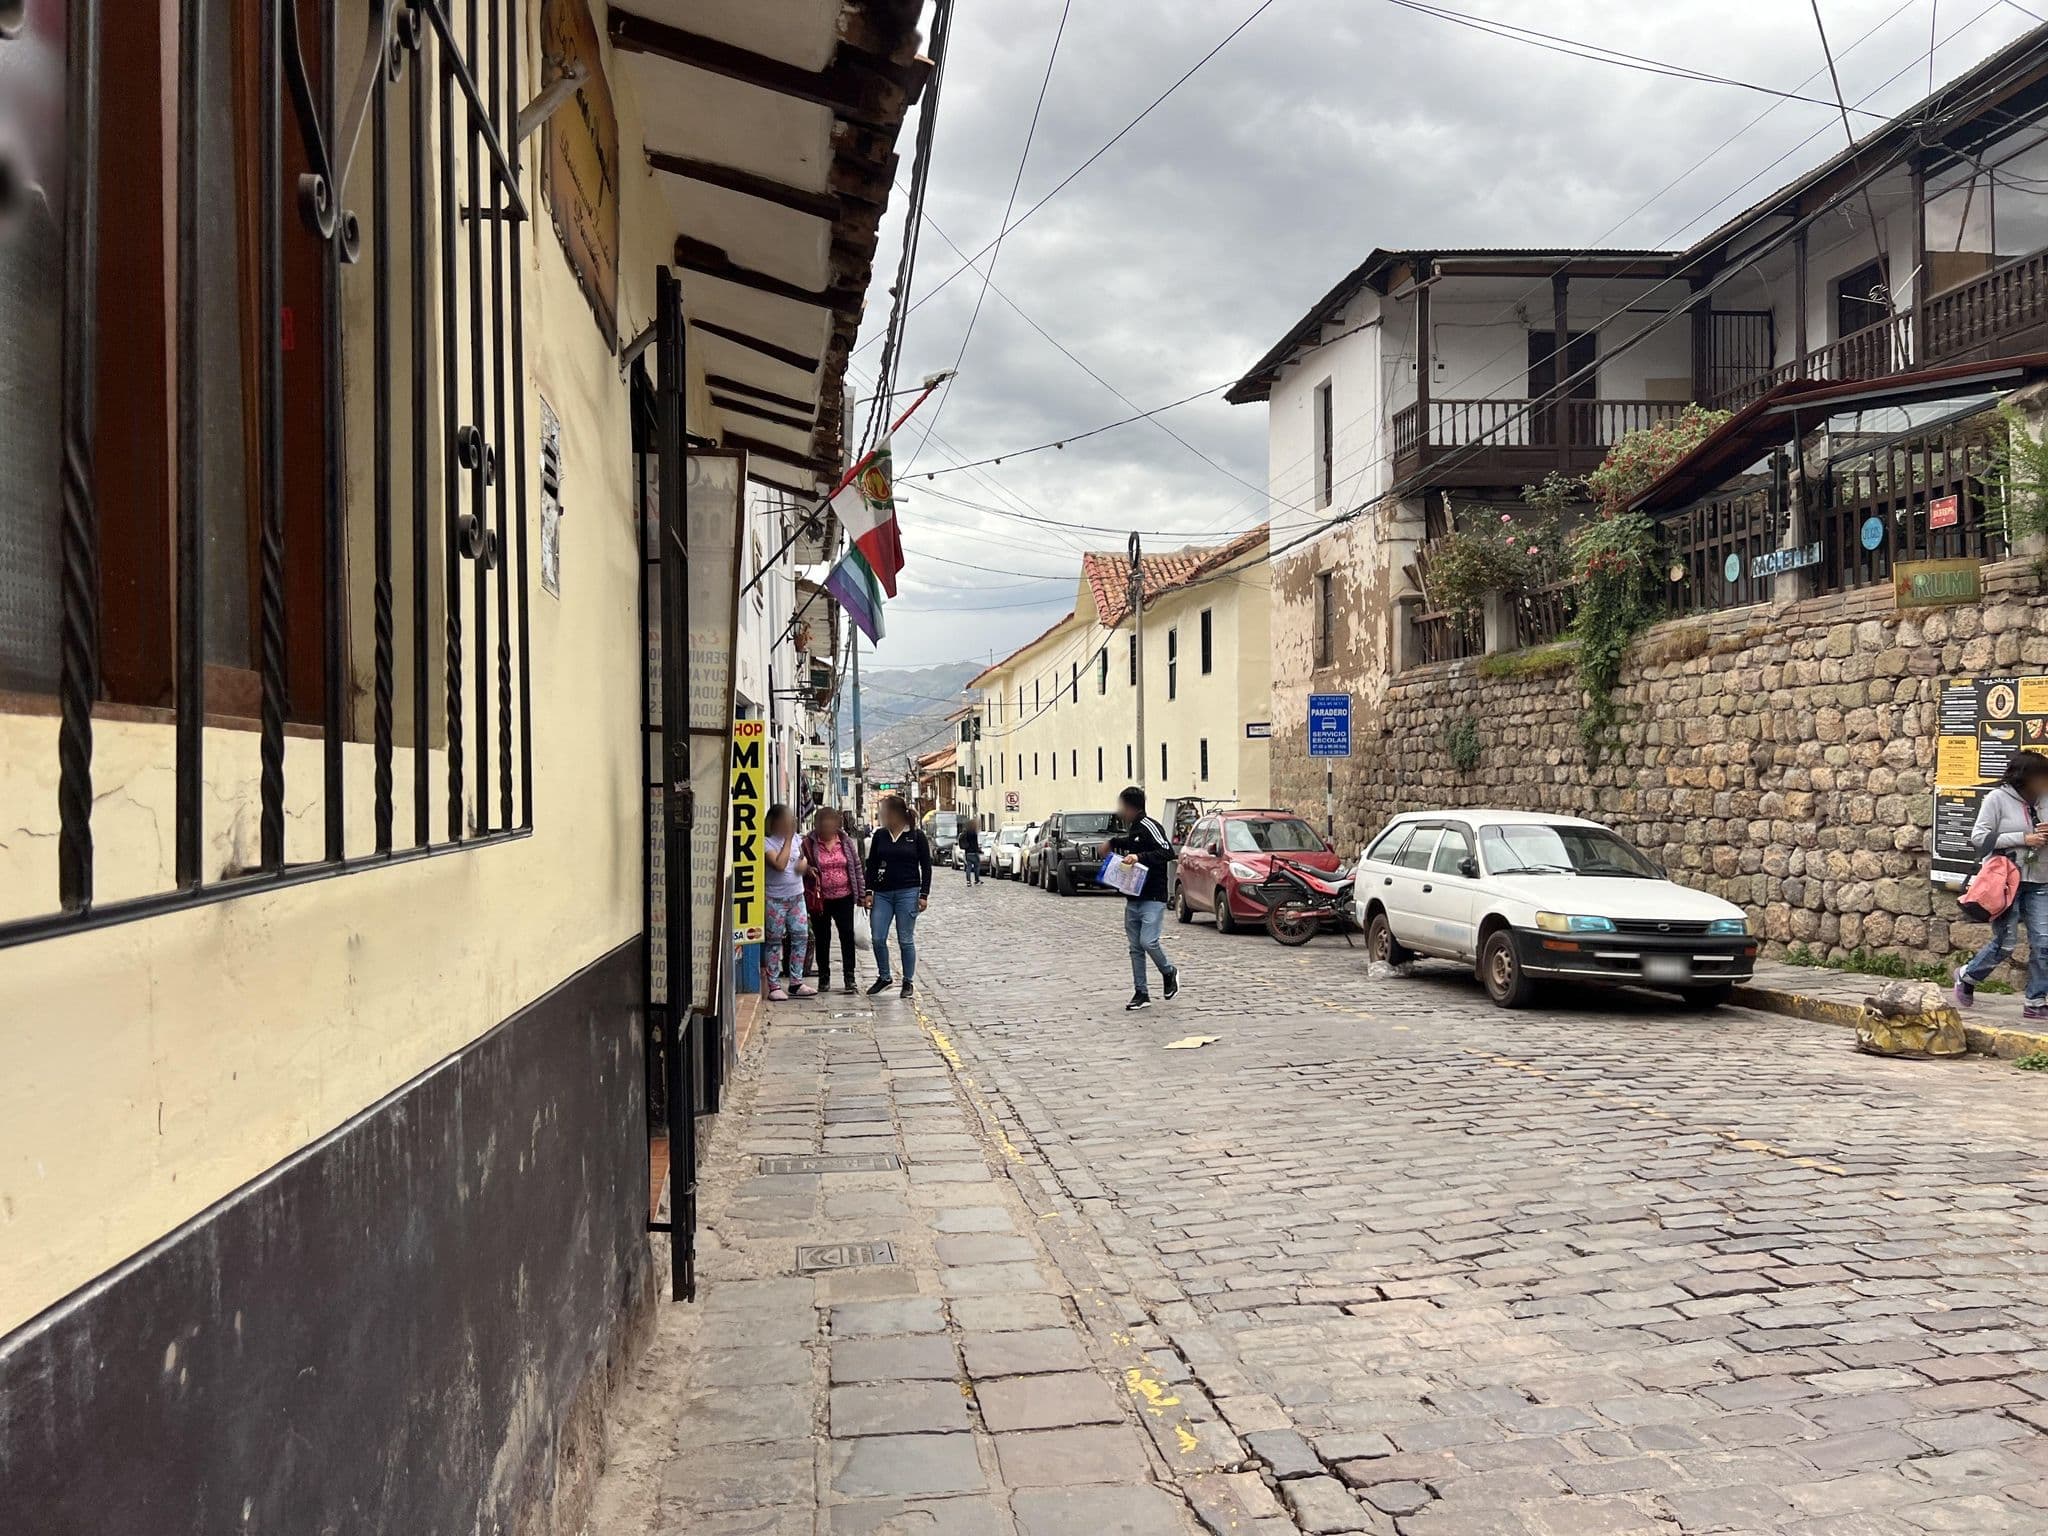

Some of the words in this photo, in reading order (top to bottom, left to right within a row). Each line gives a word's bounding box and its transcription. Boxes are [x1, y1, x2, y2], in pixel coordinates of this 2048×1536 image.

[1913, 570, 1973, 598] RUMI
[1311, 708, 1347, 716] PARADERO
[734, 723, 762, 737] HOP
[733, 741, 759, 924] MARKET
